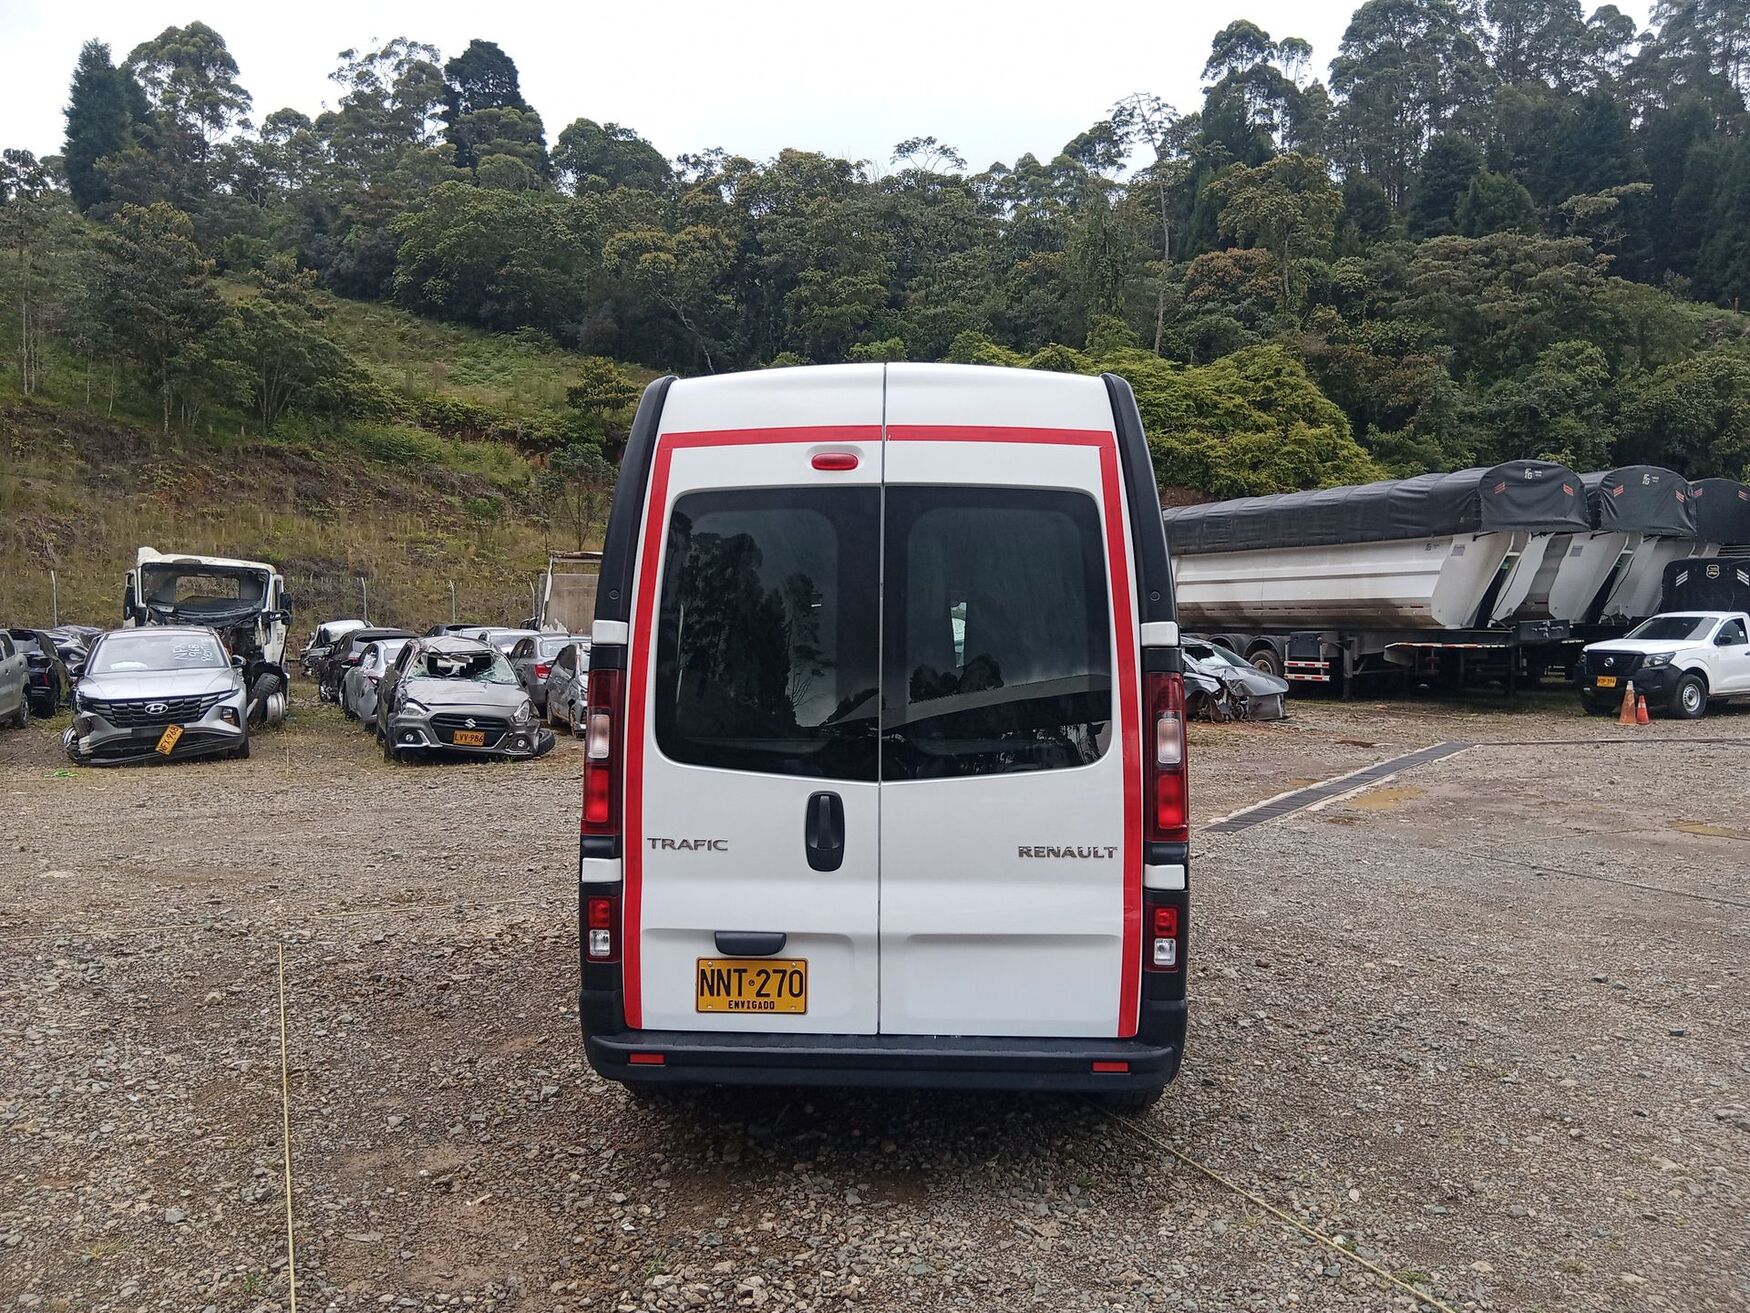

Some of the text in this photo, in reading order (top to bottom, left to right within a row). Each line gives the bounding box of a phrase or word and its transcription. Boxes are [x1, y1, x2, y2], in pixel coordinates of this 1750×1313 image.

[647, 837, 728, 851] TRAFIC
[1018, 846, 1118, 858] RENAULT
[728, 1000, 775, 1009] ENVIGADO
